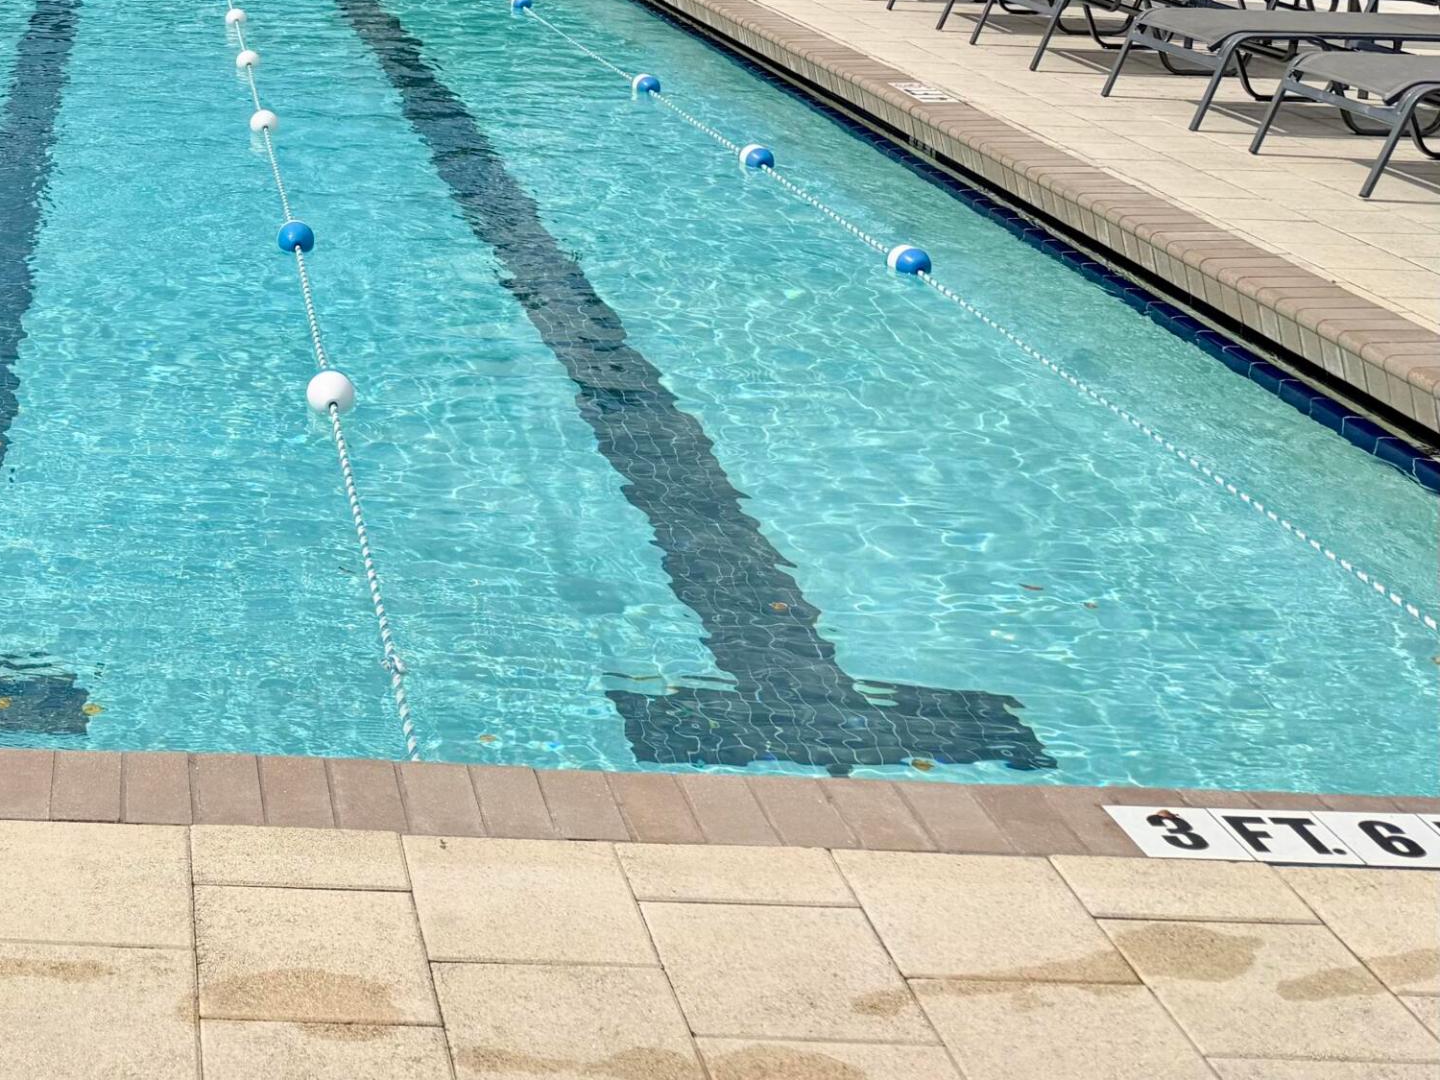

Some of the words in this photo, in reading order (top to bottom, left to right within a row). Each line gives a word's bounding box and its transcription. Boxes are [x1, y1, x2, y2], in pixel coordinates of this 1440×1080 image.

[1146, 814, 1209, 850] 3
[1221, 815, 1347, 855] FT.
[1357, 820, 1427, 858] 6
